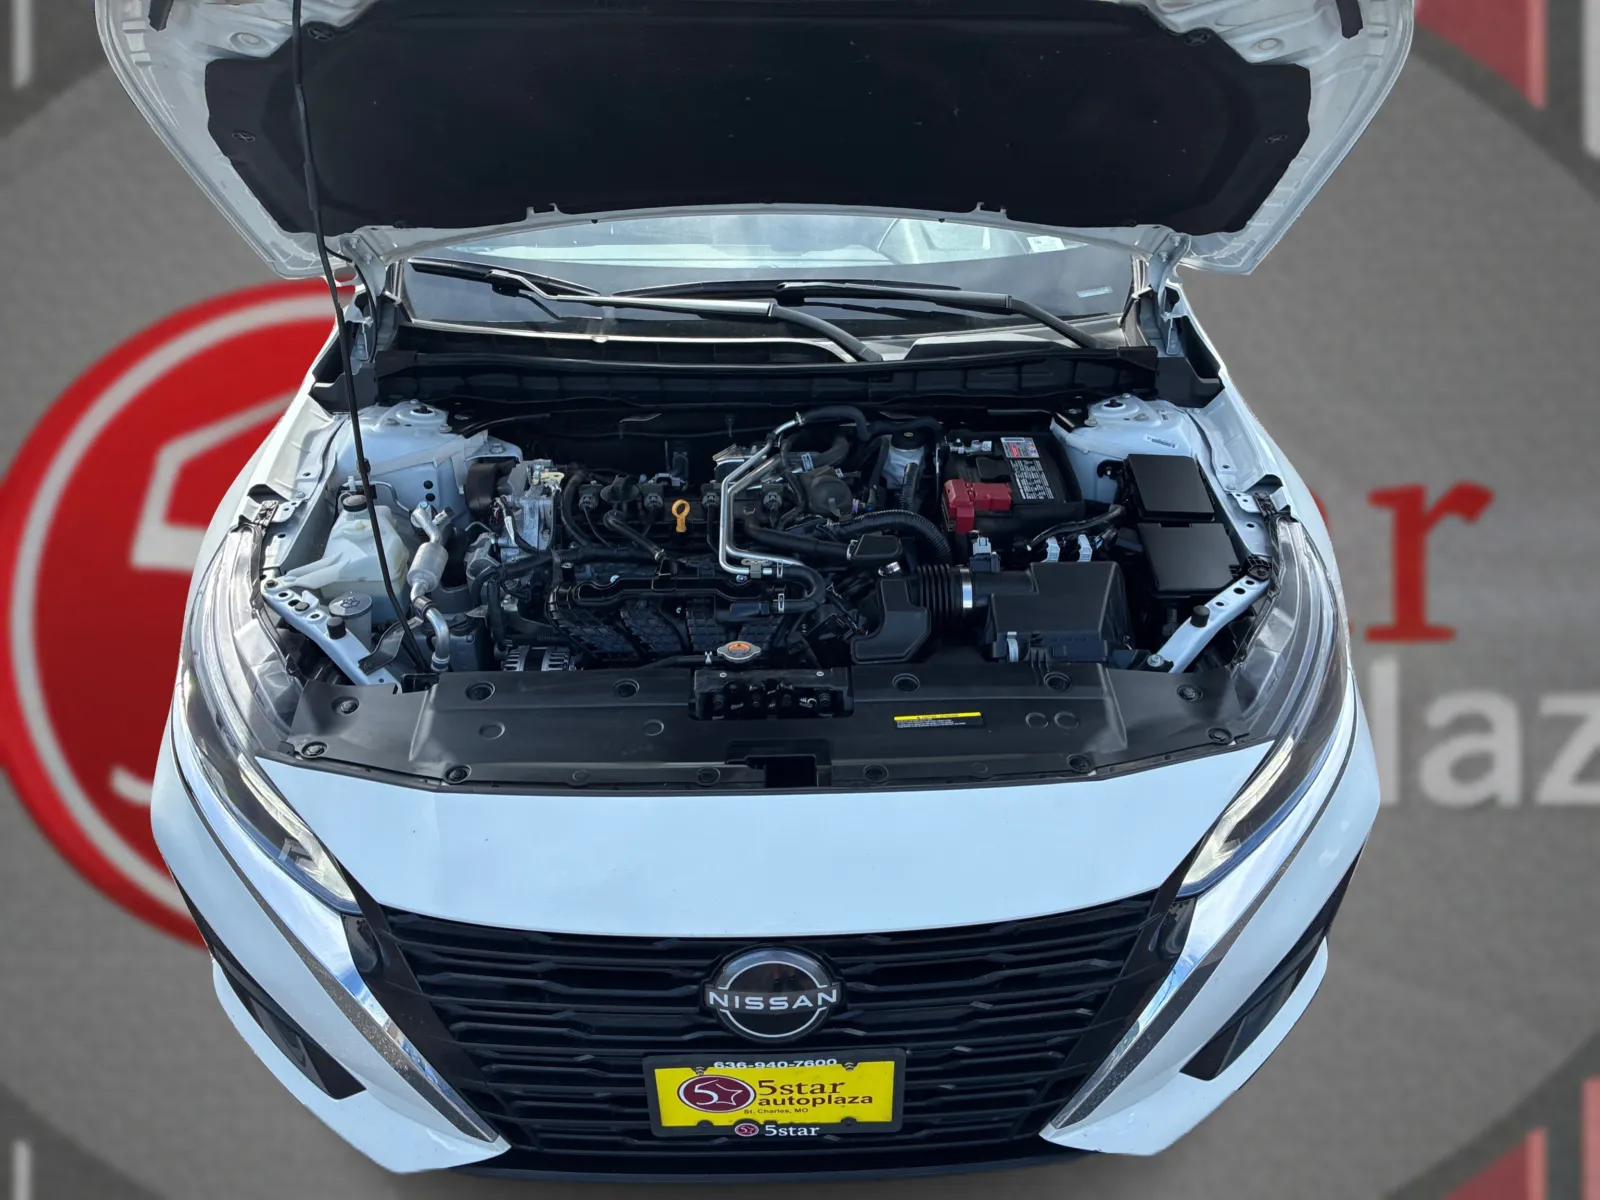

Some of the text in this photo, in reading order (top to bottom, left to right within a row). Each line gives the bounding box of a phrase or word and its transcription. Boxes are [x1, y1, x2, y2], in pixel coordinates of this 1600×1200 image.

[709, 989, 837, 1010] NISSAN
[714, 1058, 837, 1069] 636-940-7600
[758, 1080, 845, 1096] 5star
[758, 1094, 873, 1107] autoplaza
[765, 1125, 821, 1137] 5star
